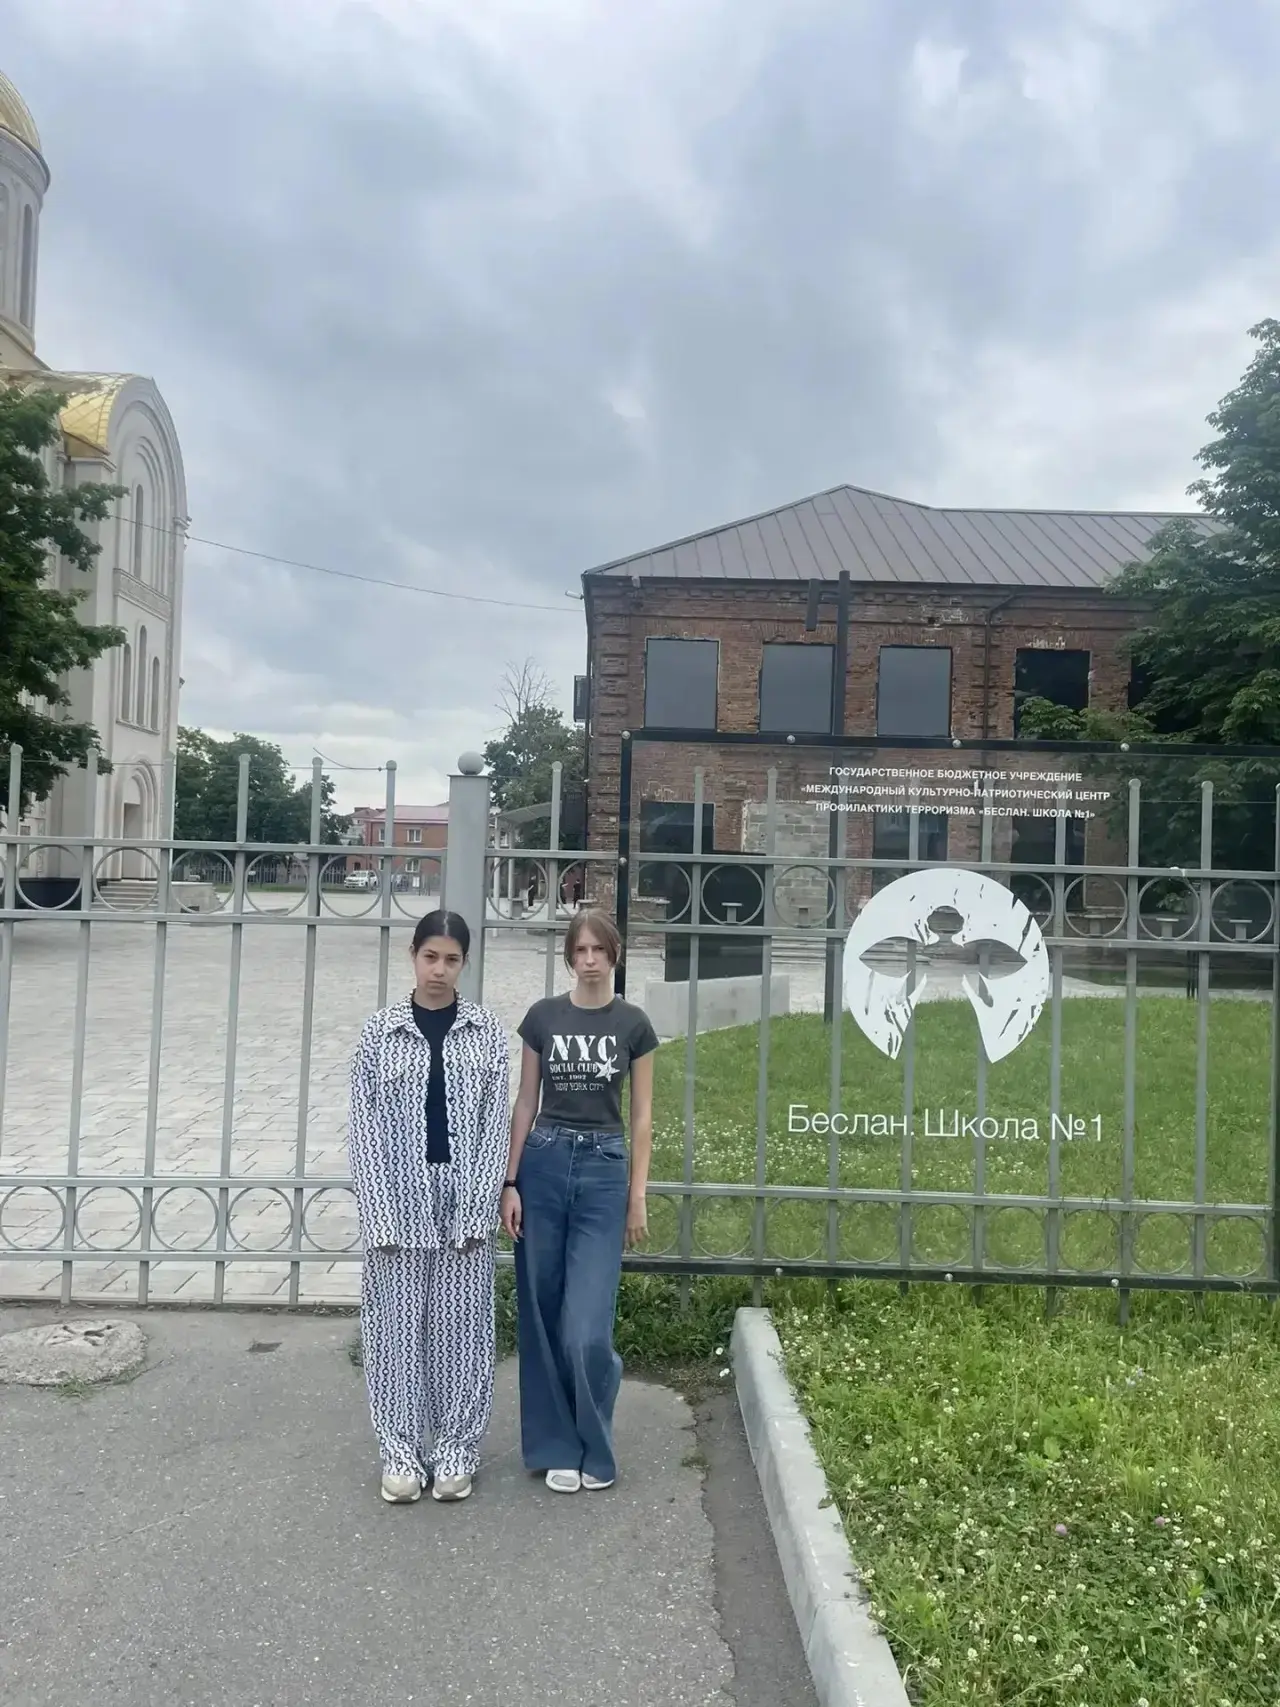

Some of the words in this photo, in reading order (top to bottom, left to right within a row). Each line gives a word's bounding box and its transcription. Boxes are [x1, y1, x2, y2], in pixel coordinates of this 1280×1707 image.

[829, 767, 935, 779] ГОСУДАРСТВЕННОЕ
[937, 769, 1007, 780] БЮДЖЕТНОЕ
[1009, 771, 1082, 782] УЧРЕЖДЕНИЕ
[801, 784, 905, 796] «МЕЖДУНАРОДНЫЙ
[1075, 790, 1110, 802] ЦЕНТР
[816, 802, 903, 814] ПРОФИЛАКТИКИ
[905, 805, 976, 816] ТЕРРОРИЗМА
[979, 807, 1031, 818] «БЕСЛАН.
[1032, 808, 1073, 819] ШКОЛА
[548, 1035, 618, 1062] NYC
[549, 1062, 576, 1073] SOCIAL
[577, 1062, 598, 1073] CLUB
[554, 1083, 568, 1091] NEW
[570, 1083, 588, 1091] YORK
[589, 1083, 604, 1091] CITY
[787, 1104, 915, 1136] Беслан.
[924, 1108, 1040, 1140] Школа
[1051, 1113, 1102, 1142] №1
